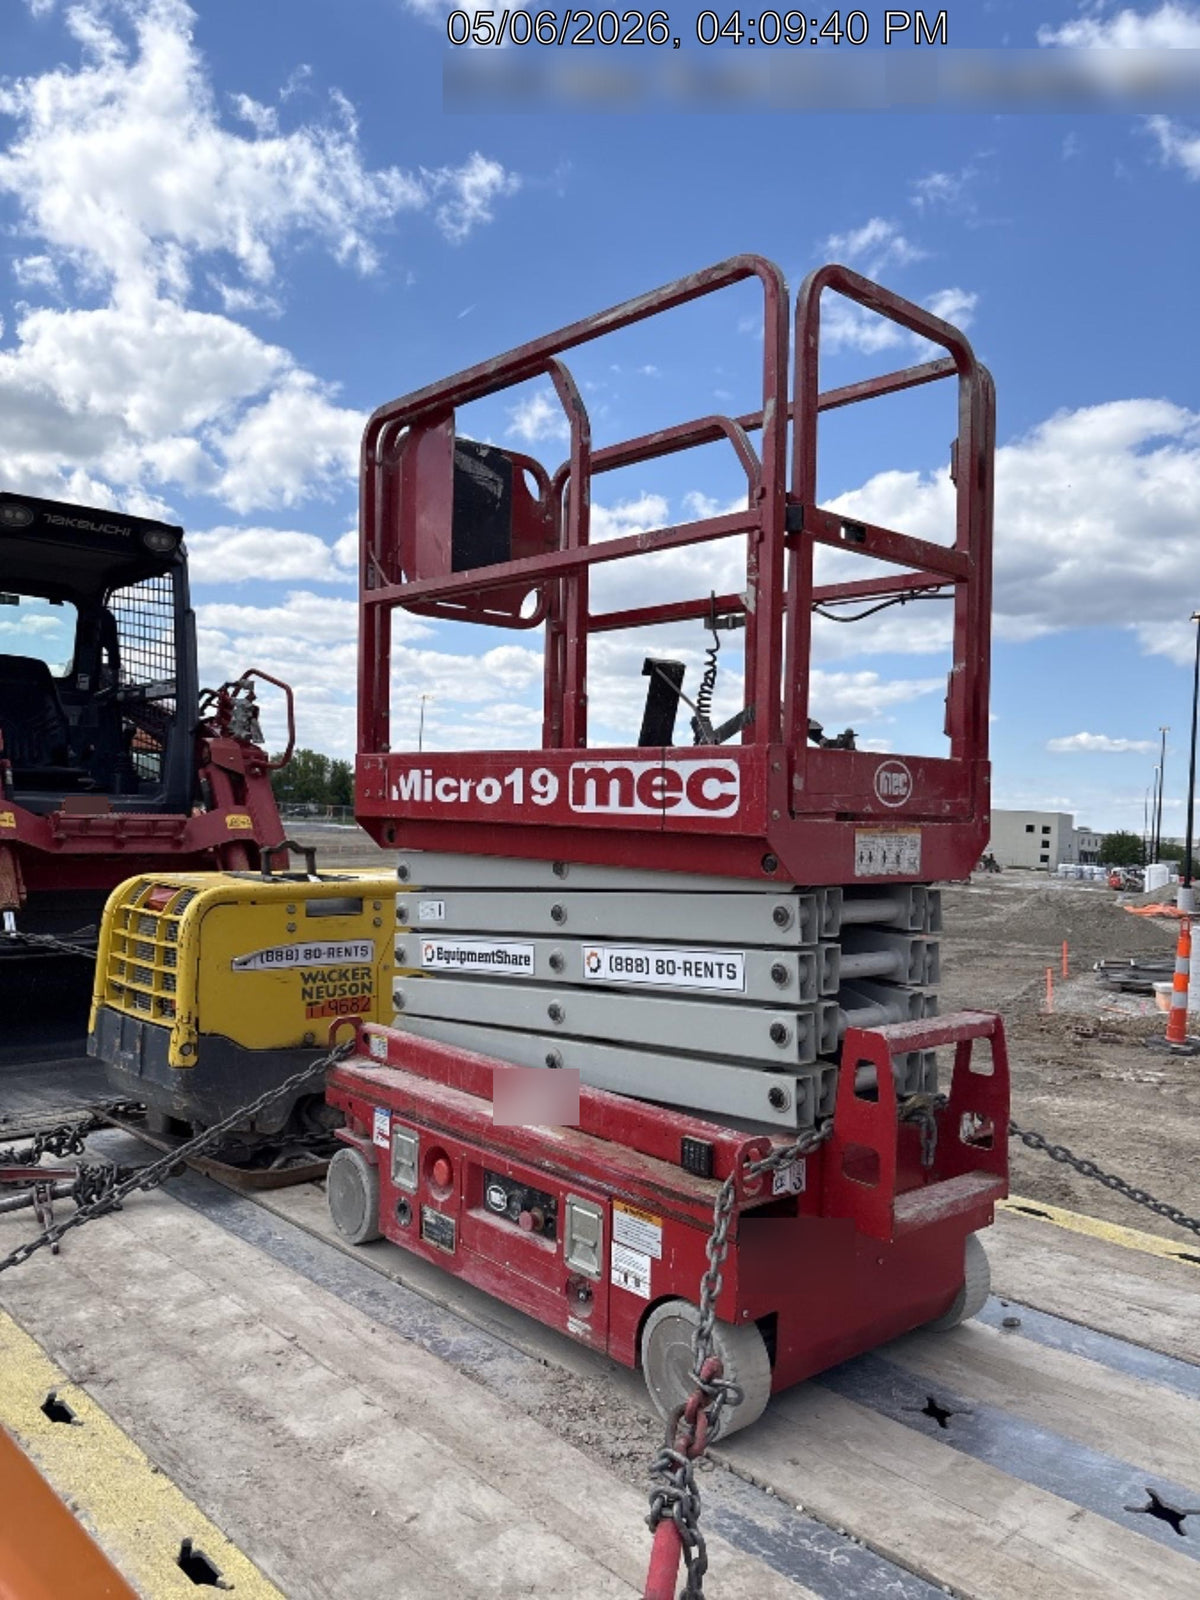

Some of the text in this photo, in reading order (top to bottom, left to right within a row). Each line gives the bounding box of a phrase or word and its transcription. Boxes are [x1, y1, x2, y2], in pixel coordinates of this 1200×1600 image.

[391, 767, 559, 806] Micro19
[572, 767, 738, 811] mec
[437, 947, 531, 966] EquipmentShare
[609, 955, 737, 980] (888) 80-RENTS
[300, 967, 372, 984] WACKER
[301, 982, 373, 1000] NEUSON
